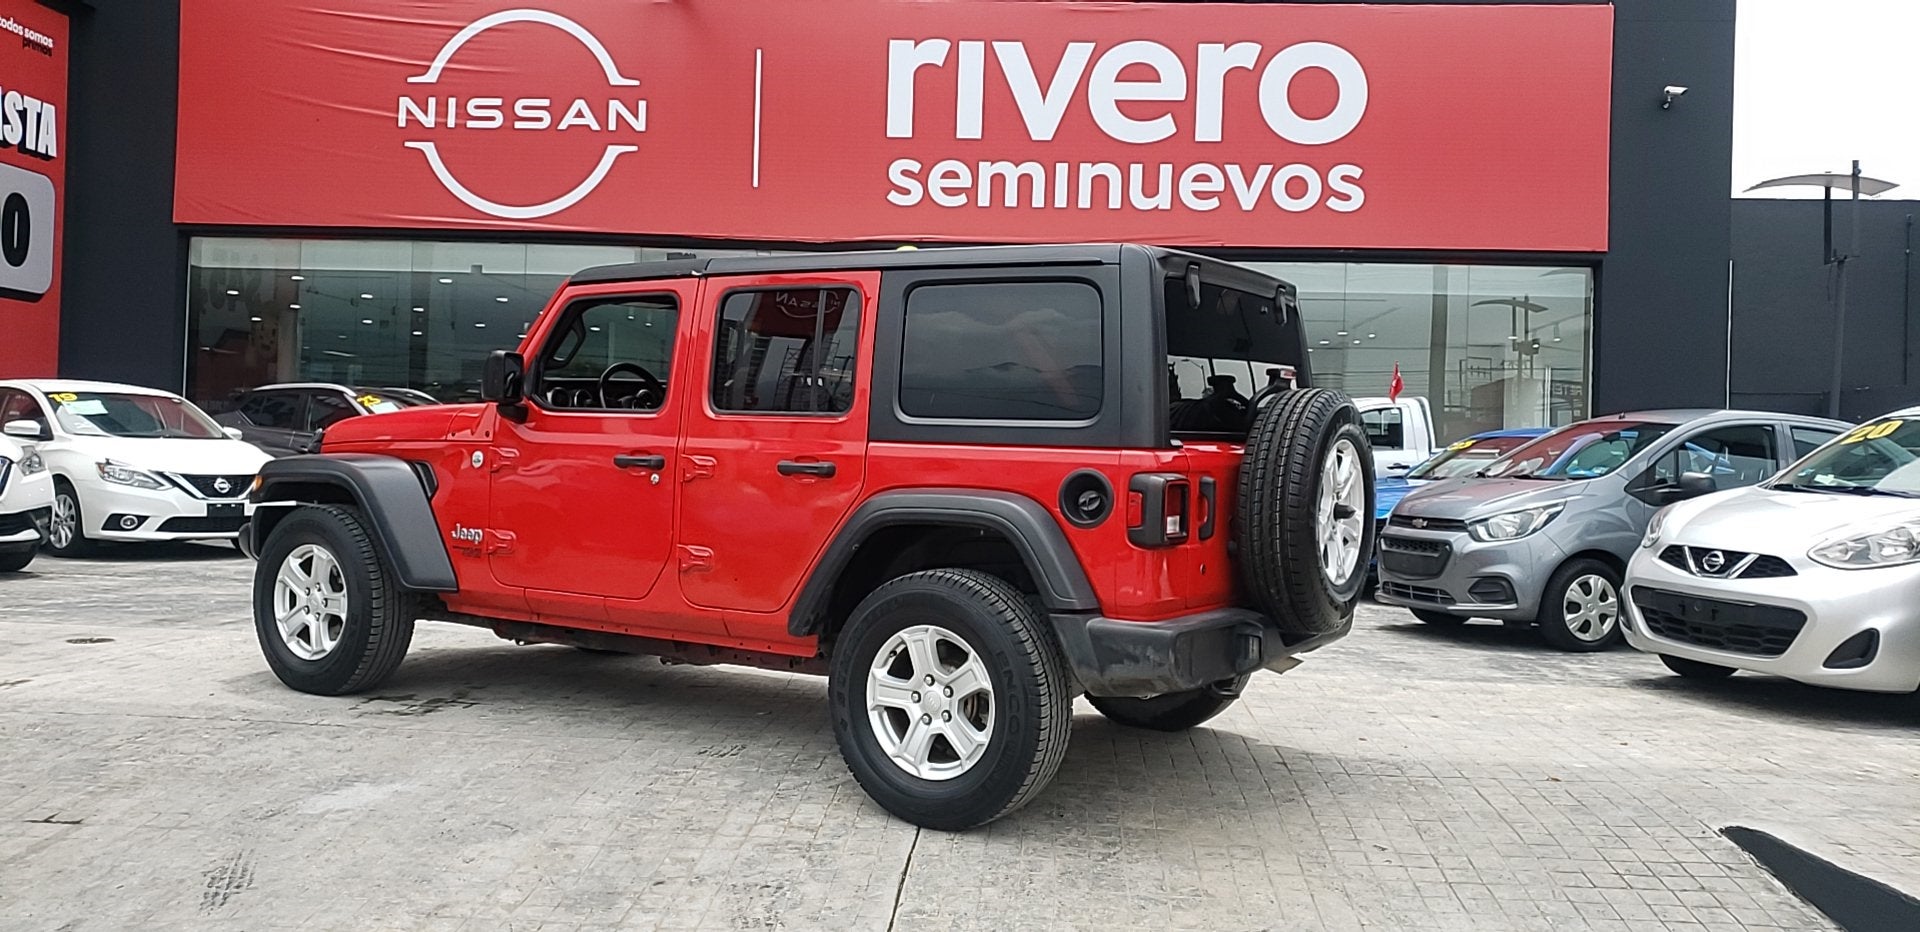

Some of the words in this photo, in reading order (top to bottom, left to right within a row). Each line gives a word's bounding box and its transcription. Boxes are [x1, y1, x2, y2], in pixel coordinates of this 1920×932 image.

[24, 28, 53, 48] somos
[886, 38, 1369, 145] rivero
[0, 86, 57, 158] STA
[397, 96, 647, 132] NISSAN
[886, 158, 1366, 212] seminuevos
[48, 393, 78, 402] 19
[1840, 420, 1904, 446] 20
[451, 523, 483, 544] Jeep
